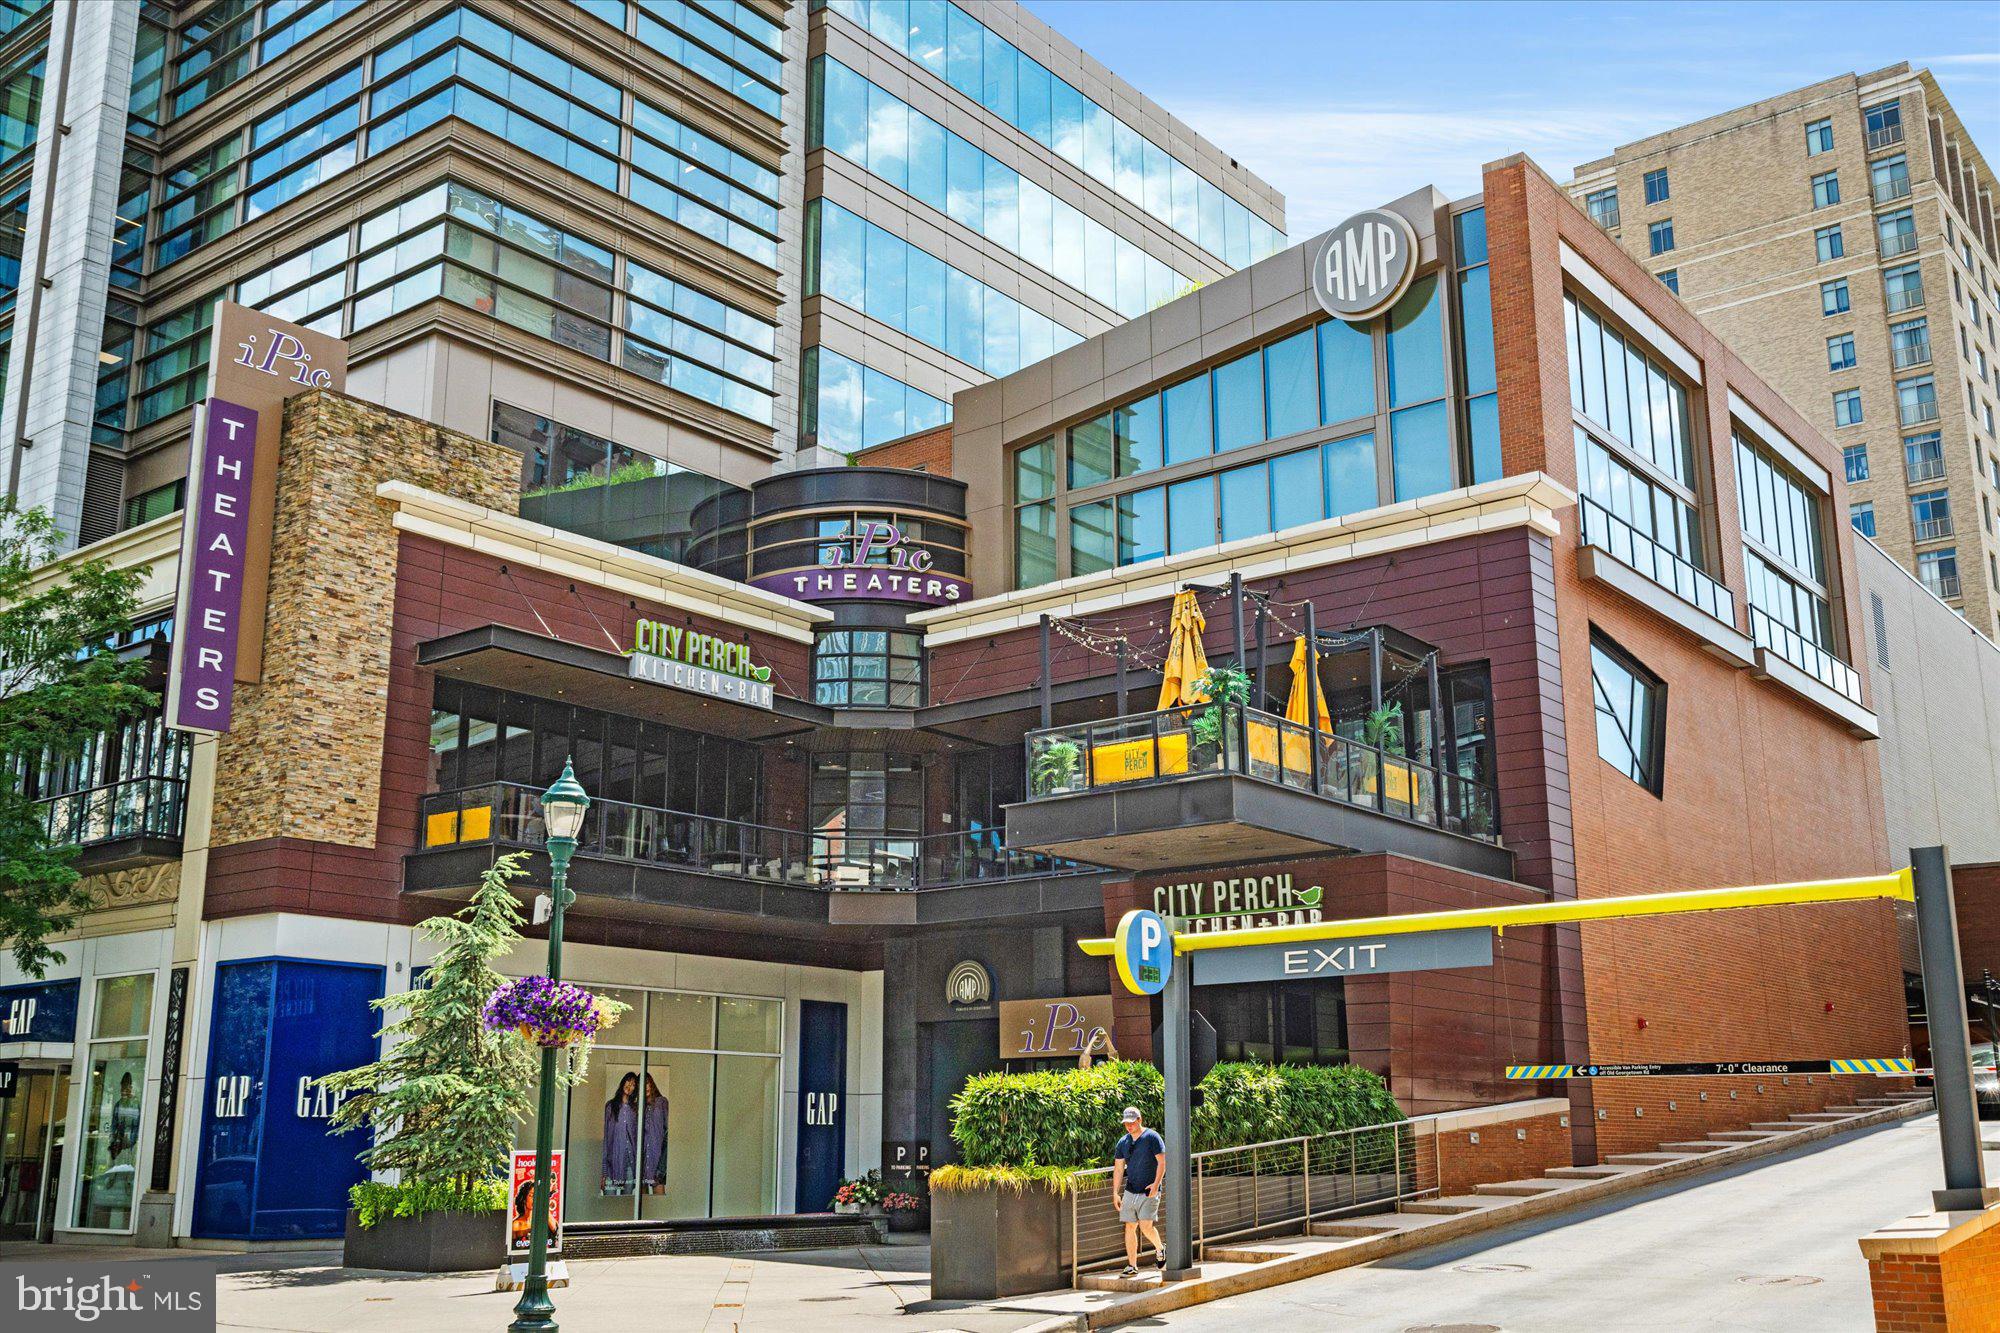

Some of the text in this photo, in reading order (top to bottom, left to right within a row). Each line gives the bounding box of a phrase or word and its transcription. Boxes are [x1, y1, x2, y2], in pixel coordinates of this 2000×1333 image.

[1325, 222, 1397, 302] AMP
[233, 328, 332, 388] iPic
[195, 418, 244, 711] THEATERS
[822, 521, 933, 573] iPic
[793, 573, 960, 600] THEATERS
[635, 618, 751, 678] CITY PERCH
[1153, 873, 1293, 917] CITY PERCH
[1141, 917, 1162, 961] P
[1284, 943, 1387, 974] EXIT
[9, 998, 37, 1036] GAP
[1715, 1063, 1788, 1073] 7'-0" Clearance
[215, 1075, 252, 1118] GAP
[806, 1092, 838, 1125] GAP
[897, 1146, 906, 1161] P
[920, 1146, 928, 1161] P
